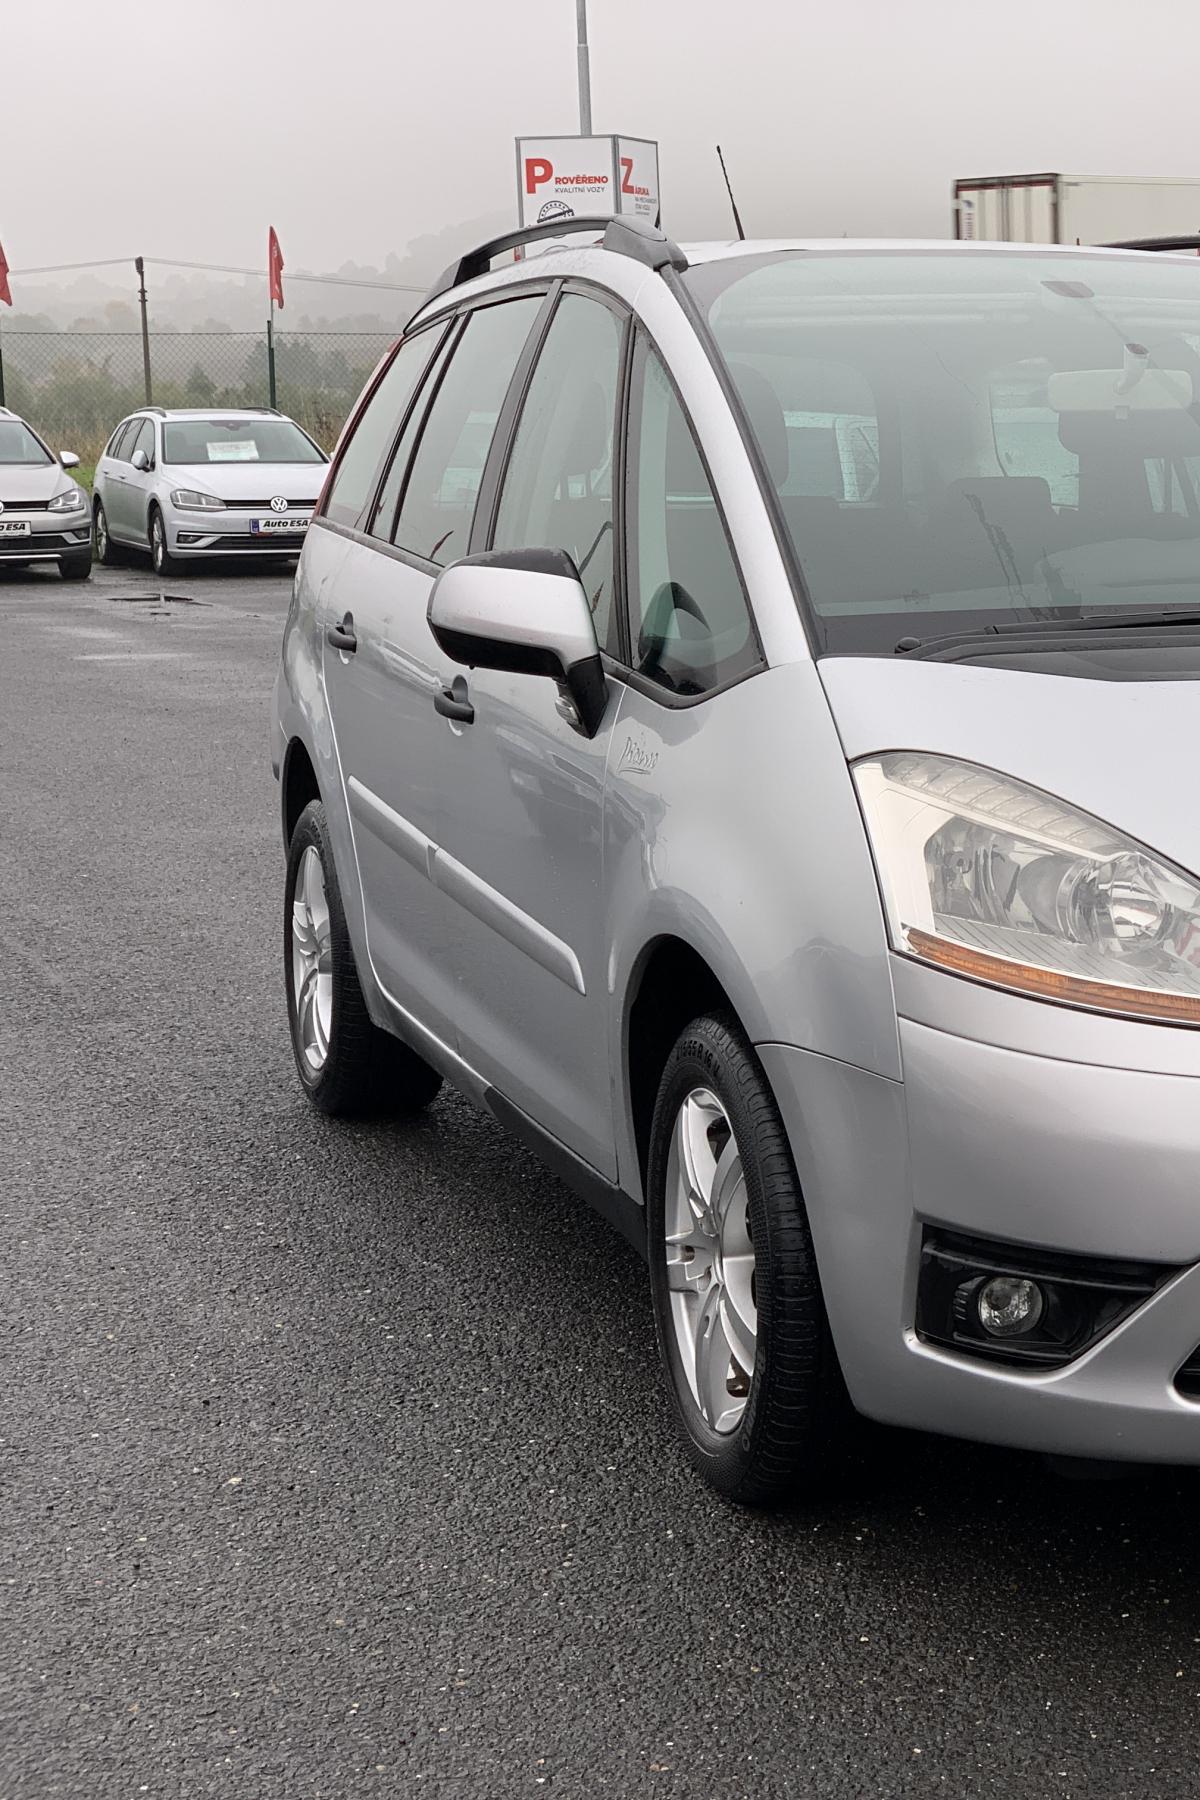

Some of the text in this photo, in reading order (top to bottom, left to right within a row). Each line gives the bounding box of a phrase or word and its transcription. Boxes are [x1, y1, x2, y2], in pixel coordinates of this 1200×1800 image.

[6, 523, 26, 531] ESA
[263, 519, 309, 528] Auto ESA
